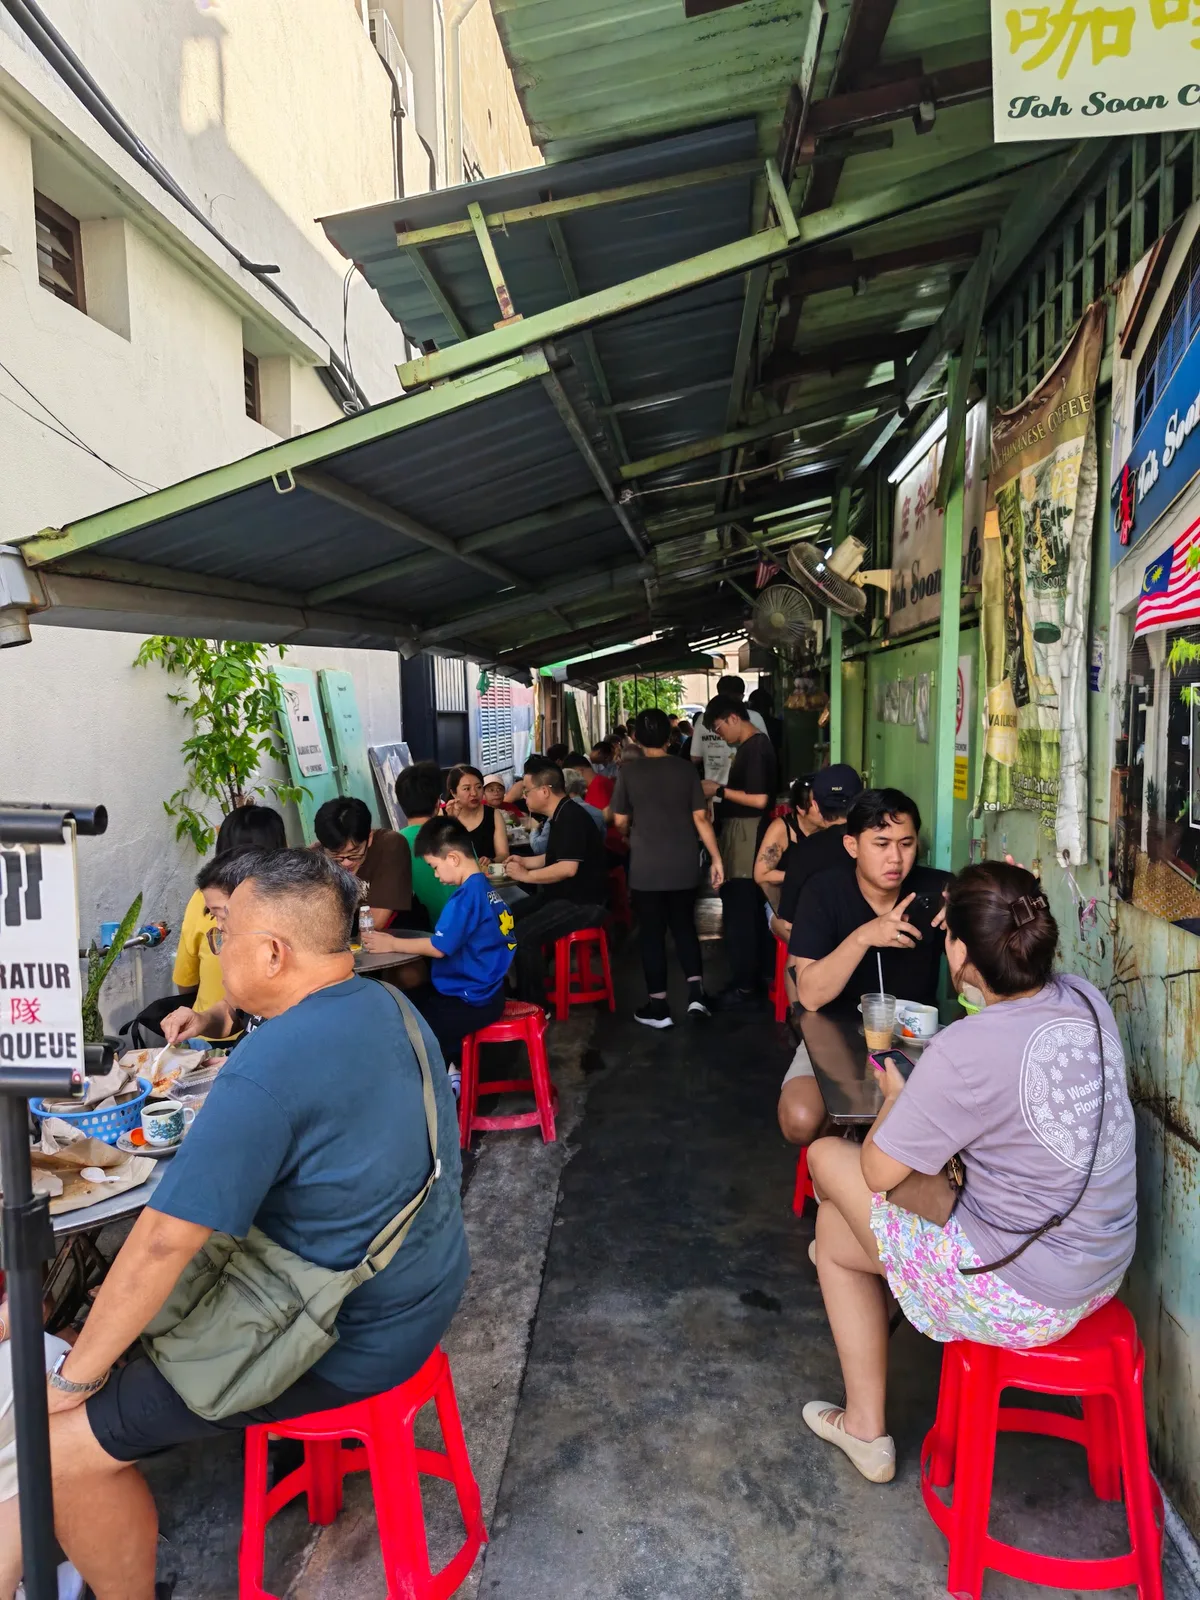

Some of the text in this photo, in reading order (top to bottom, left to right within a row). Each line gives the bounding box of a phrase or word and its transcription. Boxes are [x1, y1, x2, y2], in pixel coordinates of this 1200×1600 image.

[1008, 84, 1200, 118] Toh Soon C
[910, 560, 942, 605] Soon
[983, 801, 1000, 811] tel
[0, 1032, 77, 1062] QUEUE
